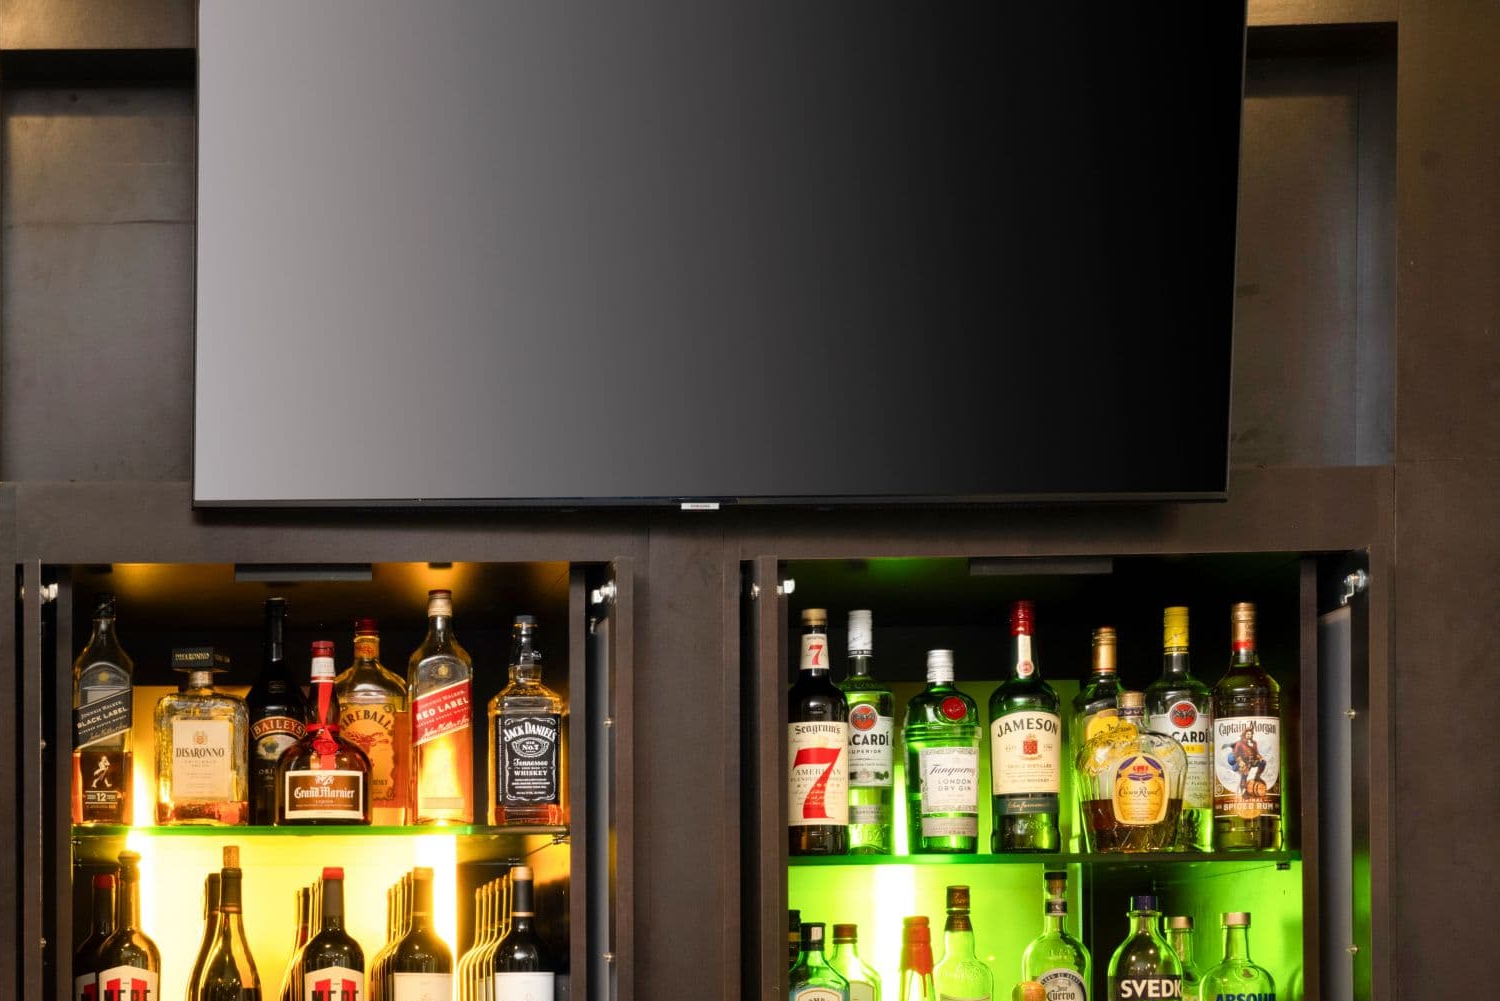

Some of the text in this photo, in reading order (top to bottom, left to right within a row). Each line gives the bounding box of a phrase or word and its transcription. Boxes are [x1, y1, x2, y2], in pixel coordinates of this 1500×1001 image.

[175, 652, 210, 661] DISARONNO
[809, 644, 824, 665] 7
[416, 707, 436, 720] RED
[438, 697, 468, 713] LABEL
[77, 715, 102, 729] BLACK
[103, 707, 128, 720] LABEL
[253, 719, 304, 738] BAILEYS
[504, 721, 557, 742] JACK DANIEL'S
[997, 718, 1058, 738] JAMESON
[1219, 720, 1276, 737] Captain Morgan
[176, 747, 224, 760] DISARONNO
[513, 758, 548, 767] Tennessee
[793, 747, 842, 819] 7
[96, 793, 107, 802] 12
[294, 786, 355, 799] Grand Marnier
[1258, 802, 1274, 810] RUM
[1046, 989, 1076, 1001] Cuervo
[1120, 979, 1182, 998] SVEDK
